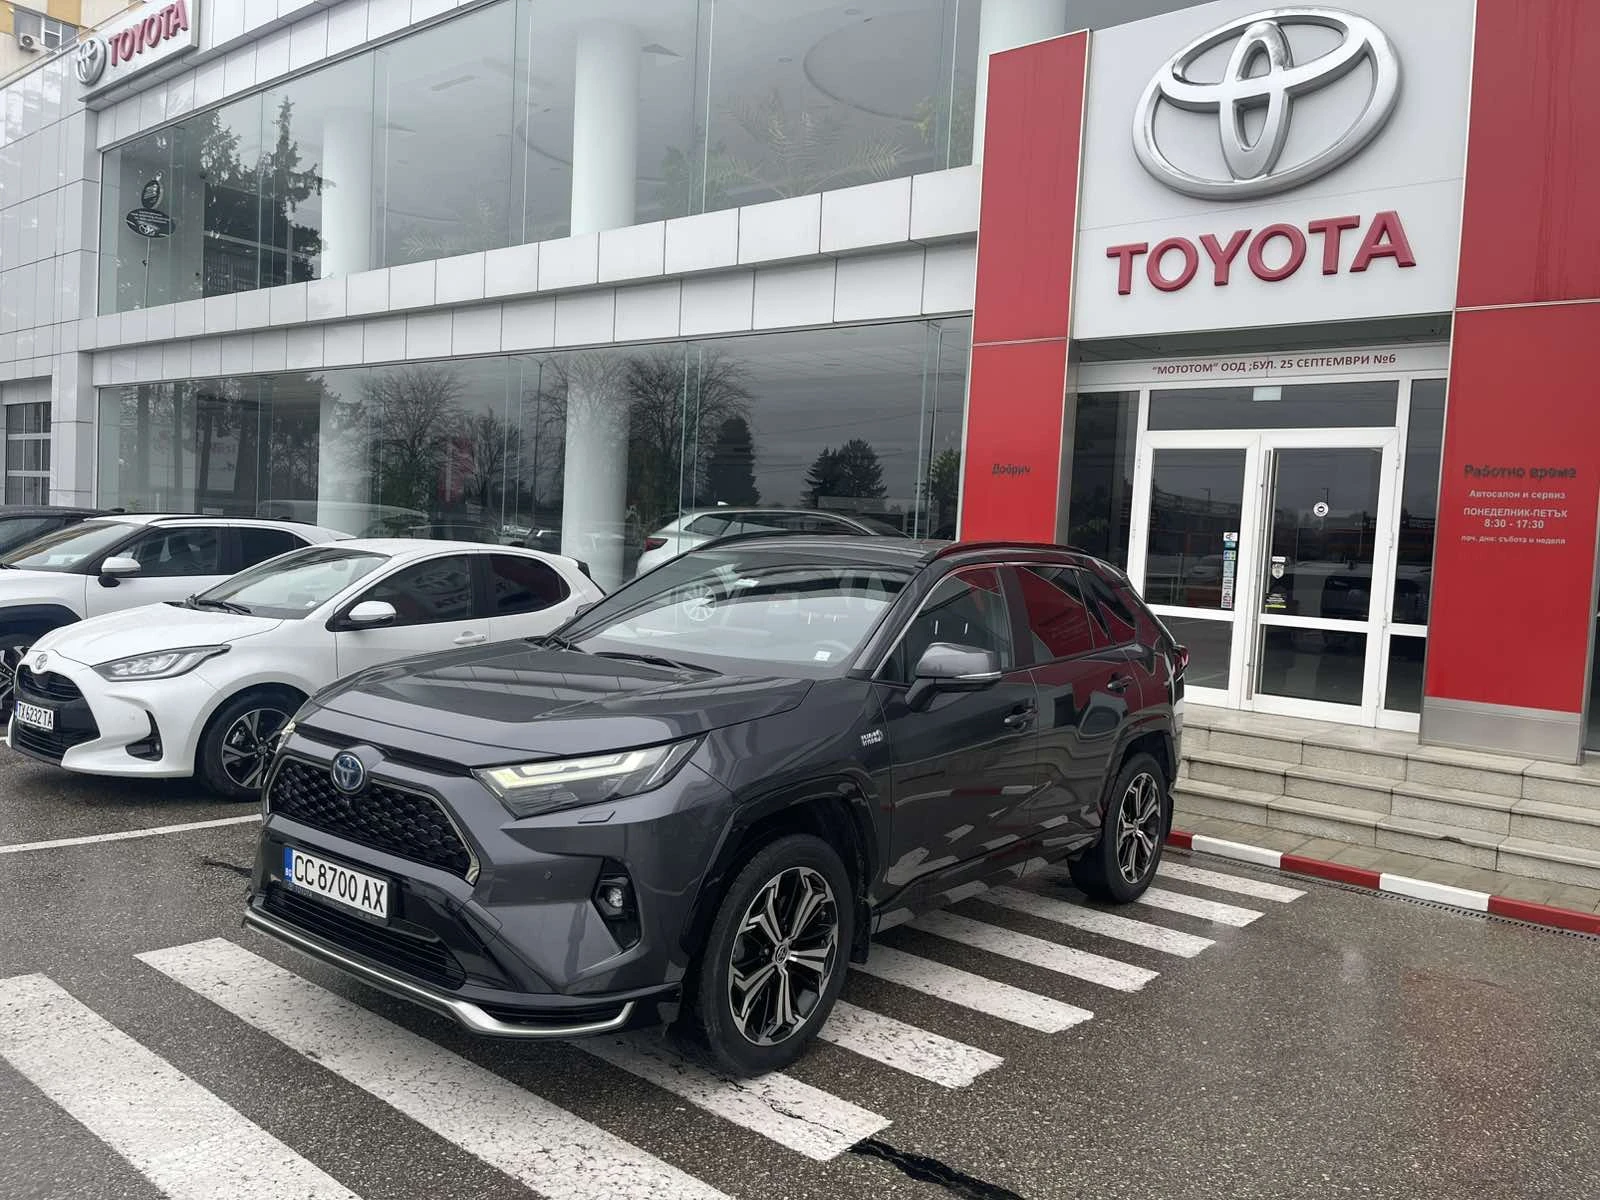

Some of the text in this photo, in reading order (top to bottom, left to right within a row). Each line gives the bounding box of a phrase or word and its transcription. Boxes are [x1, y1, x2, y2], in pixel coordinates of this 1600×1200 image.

[108, 0, 188, 67] TOYOTA
[1106, 210, 1416, 295] TOYOTA
[1221, 362, 1246, 372] ООД
[1280, 359, 1293, 369] 25
[1297, 355, 1370, 368] СЕПТЕМВРИ
[1373, 353, 1396, 365] №6
[992, 464, 1031, 476] Добрич
[1464, 464, 1577, 480] Работно време
[1469, 489, 1567, 501] Автосалон и сервиз
[1463, 507, 1568, 518] ПОНЕДЕЛНИК-ПЕТЪК
[1484, 519, 1506, 528] 8:30
[1517, 519, 1544, 529] 17:30
[26, 705, 42, 725] 6232
[43, 711, 53, 728] TA
[295, 855, 385, 913] CC 8700 AX
